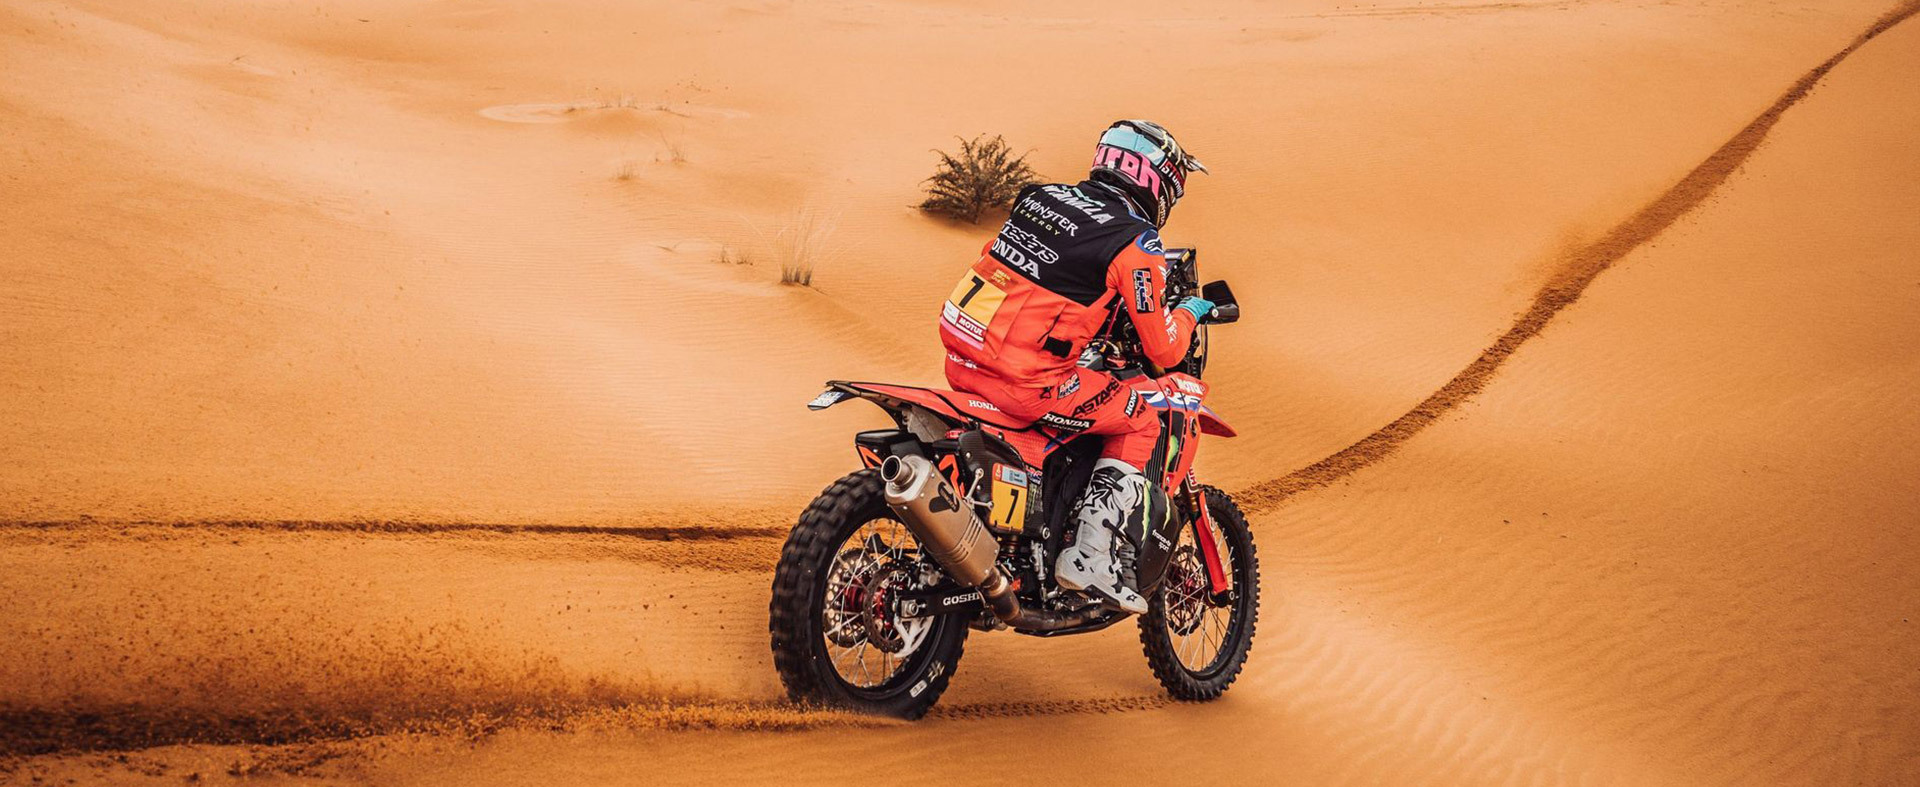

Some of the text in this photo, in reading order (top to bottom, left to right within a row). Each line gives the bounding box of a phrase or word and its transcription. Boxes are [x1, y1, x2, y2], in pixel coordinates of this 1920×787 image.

[1020, 209, 1060, 236] ENERGY
[1022, 197, 1079, 236] MONSTER
[958, 275, 985, 309] 7
[959, 317, 984, 336] MOTUL
[1043, 412, 1090, 429] HONDA
[1005, 489, 1020, 524] 7
[943, 593, 980, 606] GOSHI
